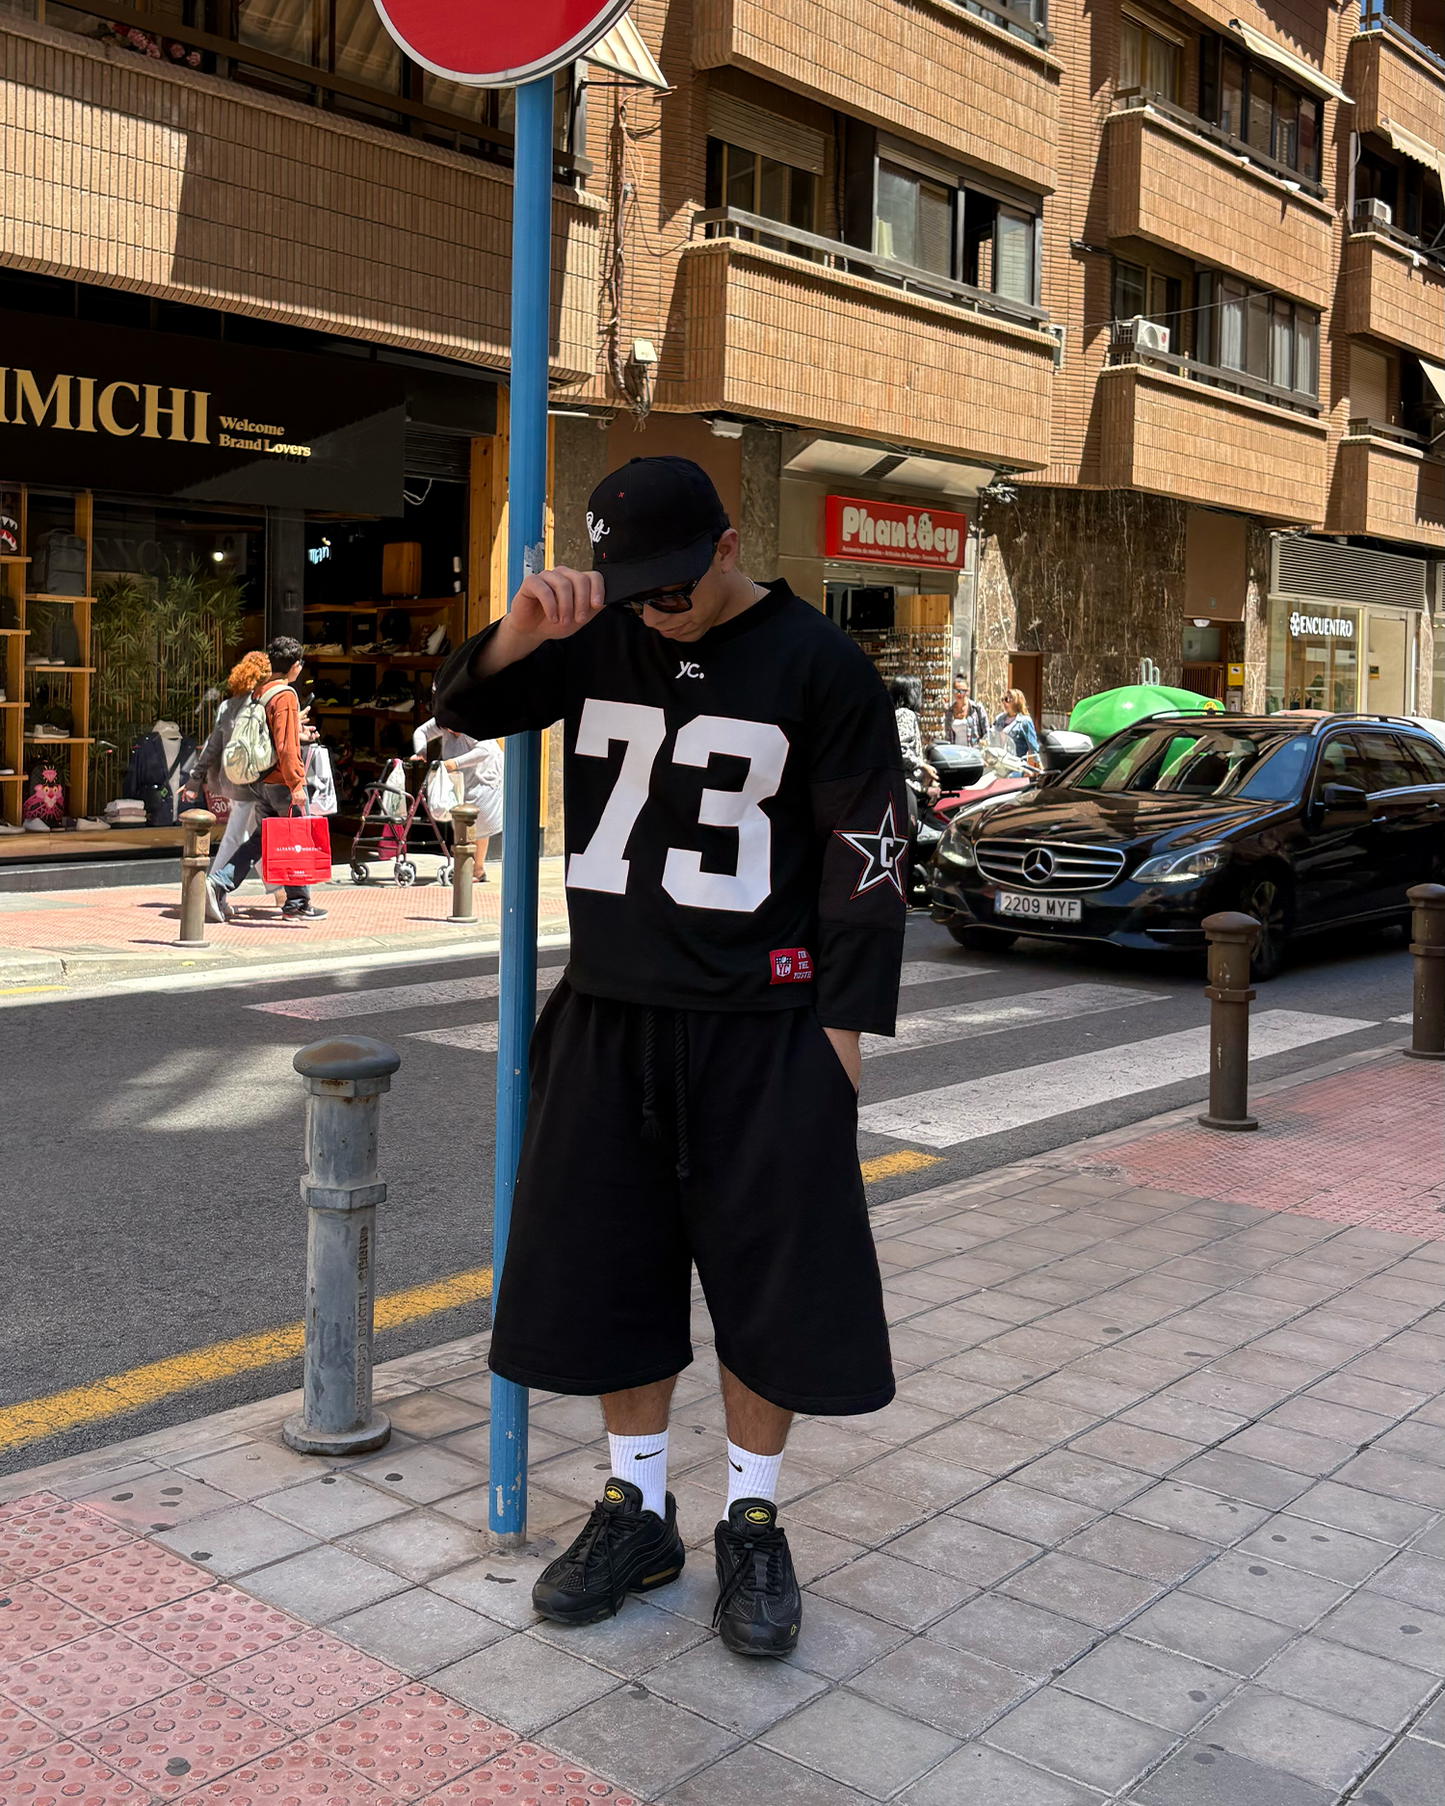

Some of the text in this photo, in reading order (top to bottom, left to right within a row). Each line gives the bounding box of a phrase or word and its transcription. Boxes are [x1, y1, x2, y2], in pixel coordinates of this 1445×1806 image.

[219, 415, 285, 436] Welcome
[219, 434, 311, 457] Brand Lovers
[1300, 615, 1353, 638] ENCUENTRO
[566, 698, 790, 912] 73
[880, 837, 894, 868] C
[1004, 895, 1077, 917] 2209 MYF
